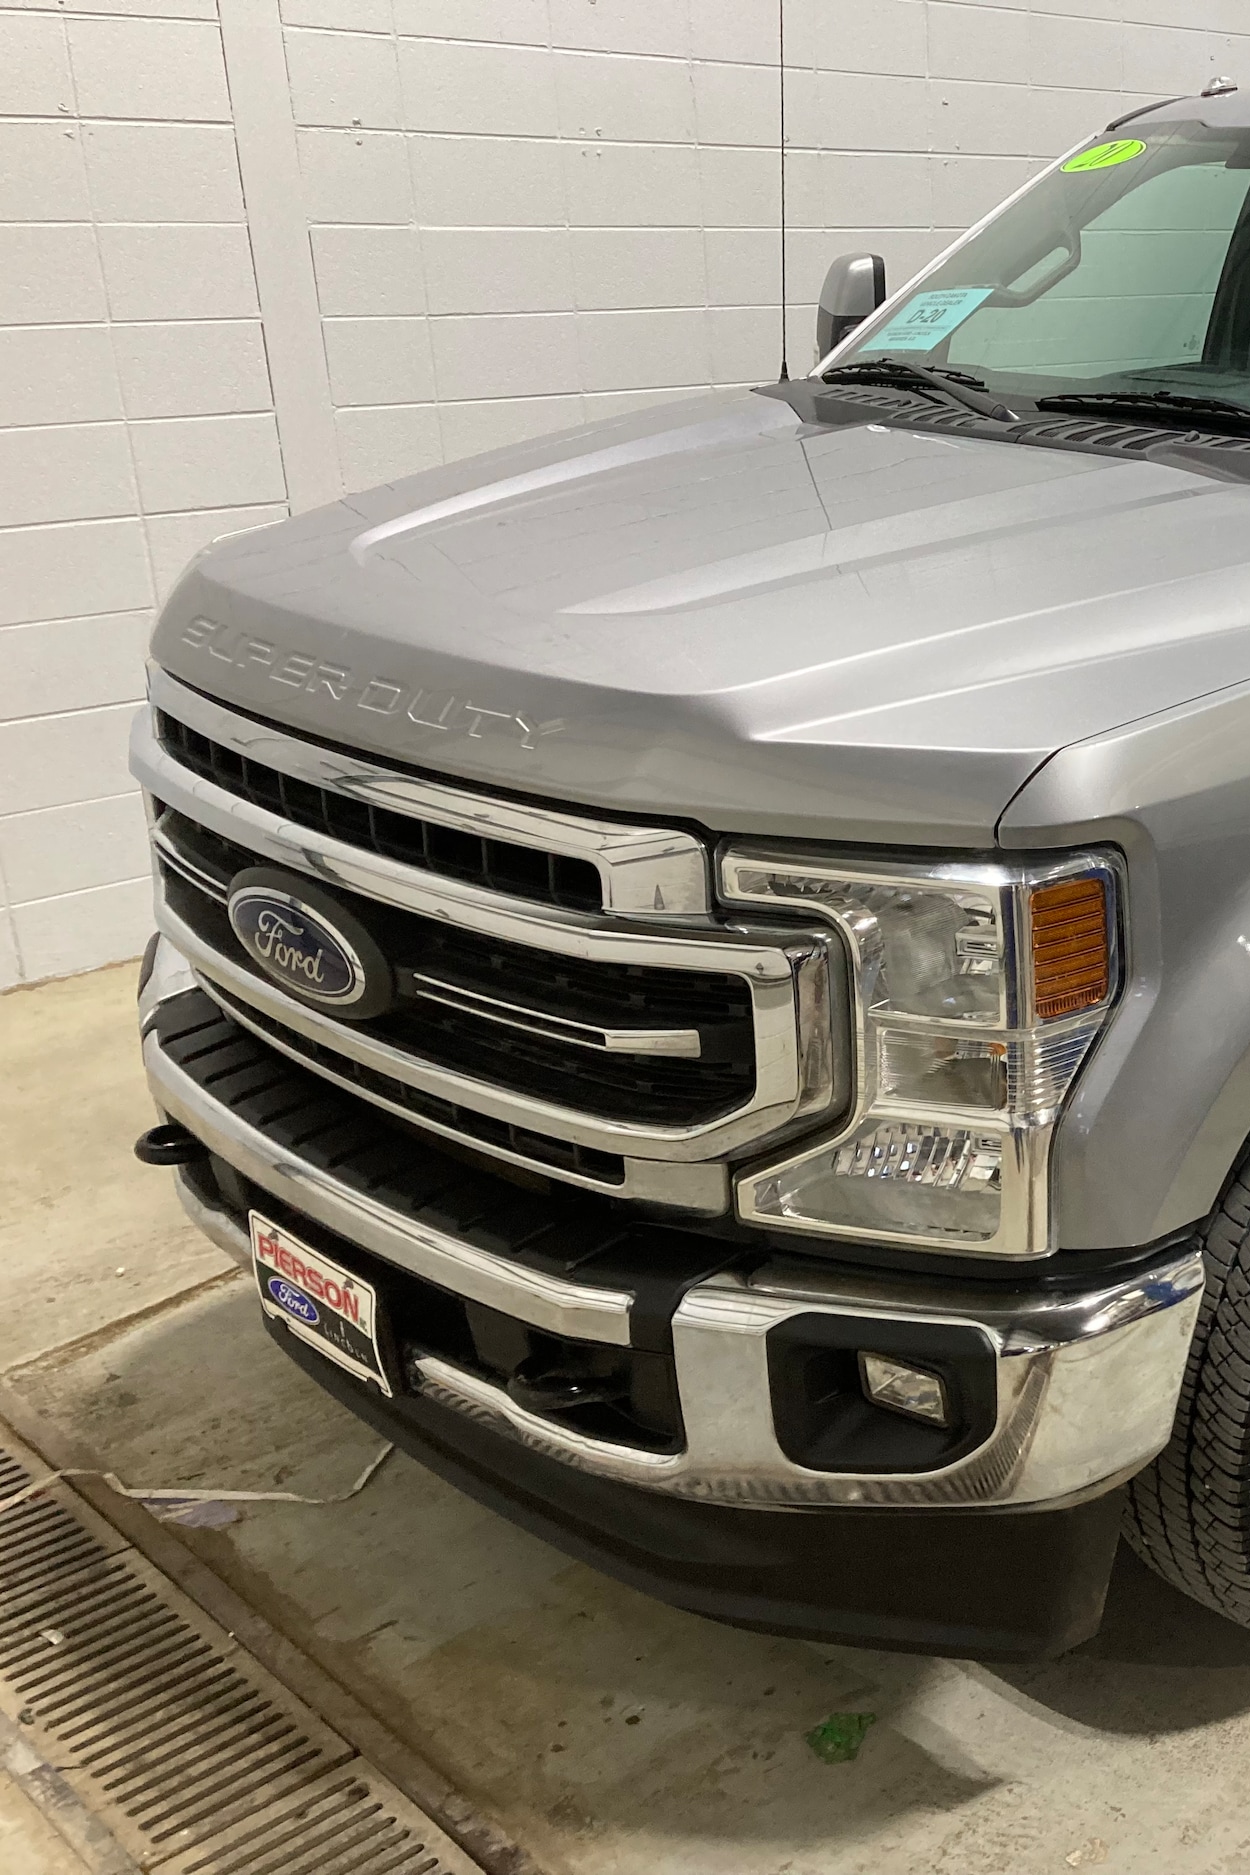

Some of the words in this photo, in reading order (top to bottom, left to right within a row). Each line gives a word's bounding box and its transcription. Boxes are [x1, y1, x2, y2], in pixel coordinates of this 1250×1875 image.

[906, 308, 947, 324] D-20
[180, 613, 352, 701] SUPER
[357, 676, 567, 750] DUTY
[255, 909, 325, 983] Ford
[257, 1231, 360, 1323] PIERSON
[278, 1283, 310, 1318] Ford
